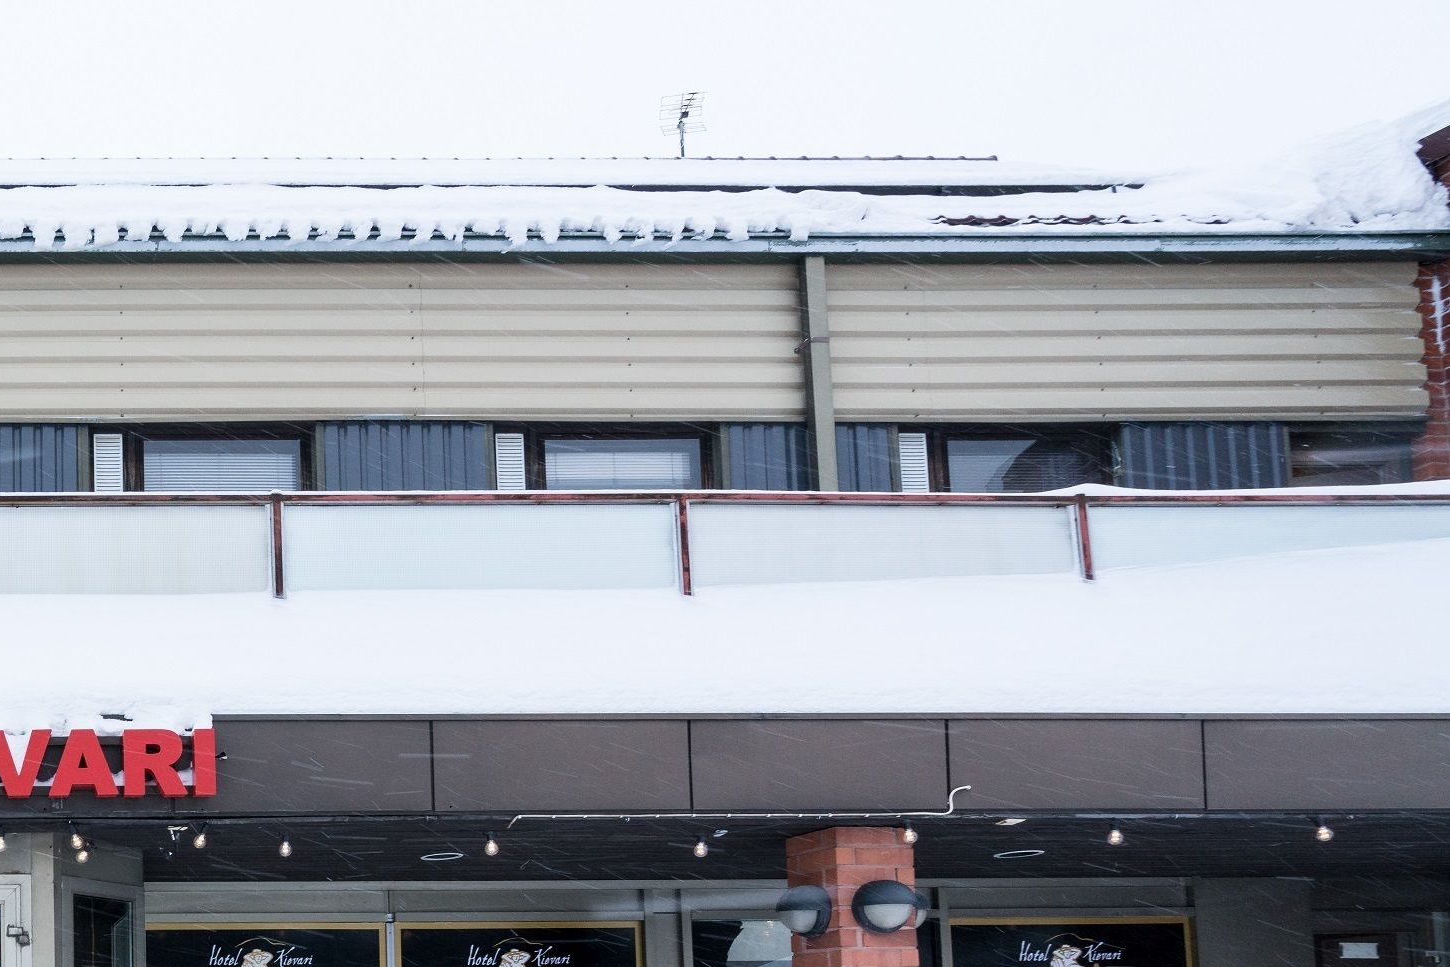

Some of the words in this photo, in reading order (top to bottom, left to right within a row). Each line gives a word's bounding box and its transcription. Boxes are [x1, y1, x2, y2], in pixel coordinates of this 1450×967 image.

[209, 944, 244, 966] Hotel
[273, 946, 313, 967] Kievari
[467, 944, 501, 966] Hotel
[531, 946, 571, 967] Kievari
[1018, 940, 1052, 962] Hotel
[1082, 941, 1122, 962] Kievari
